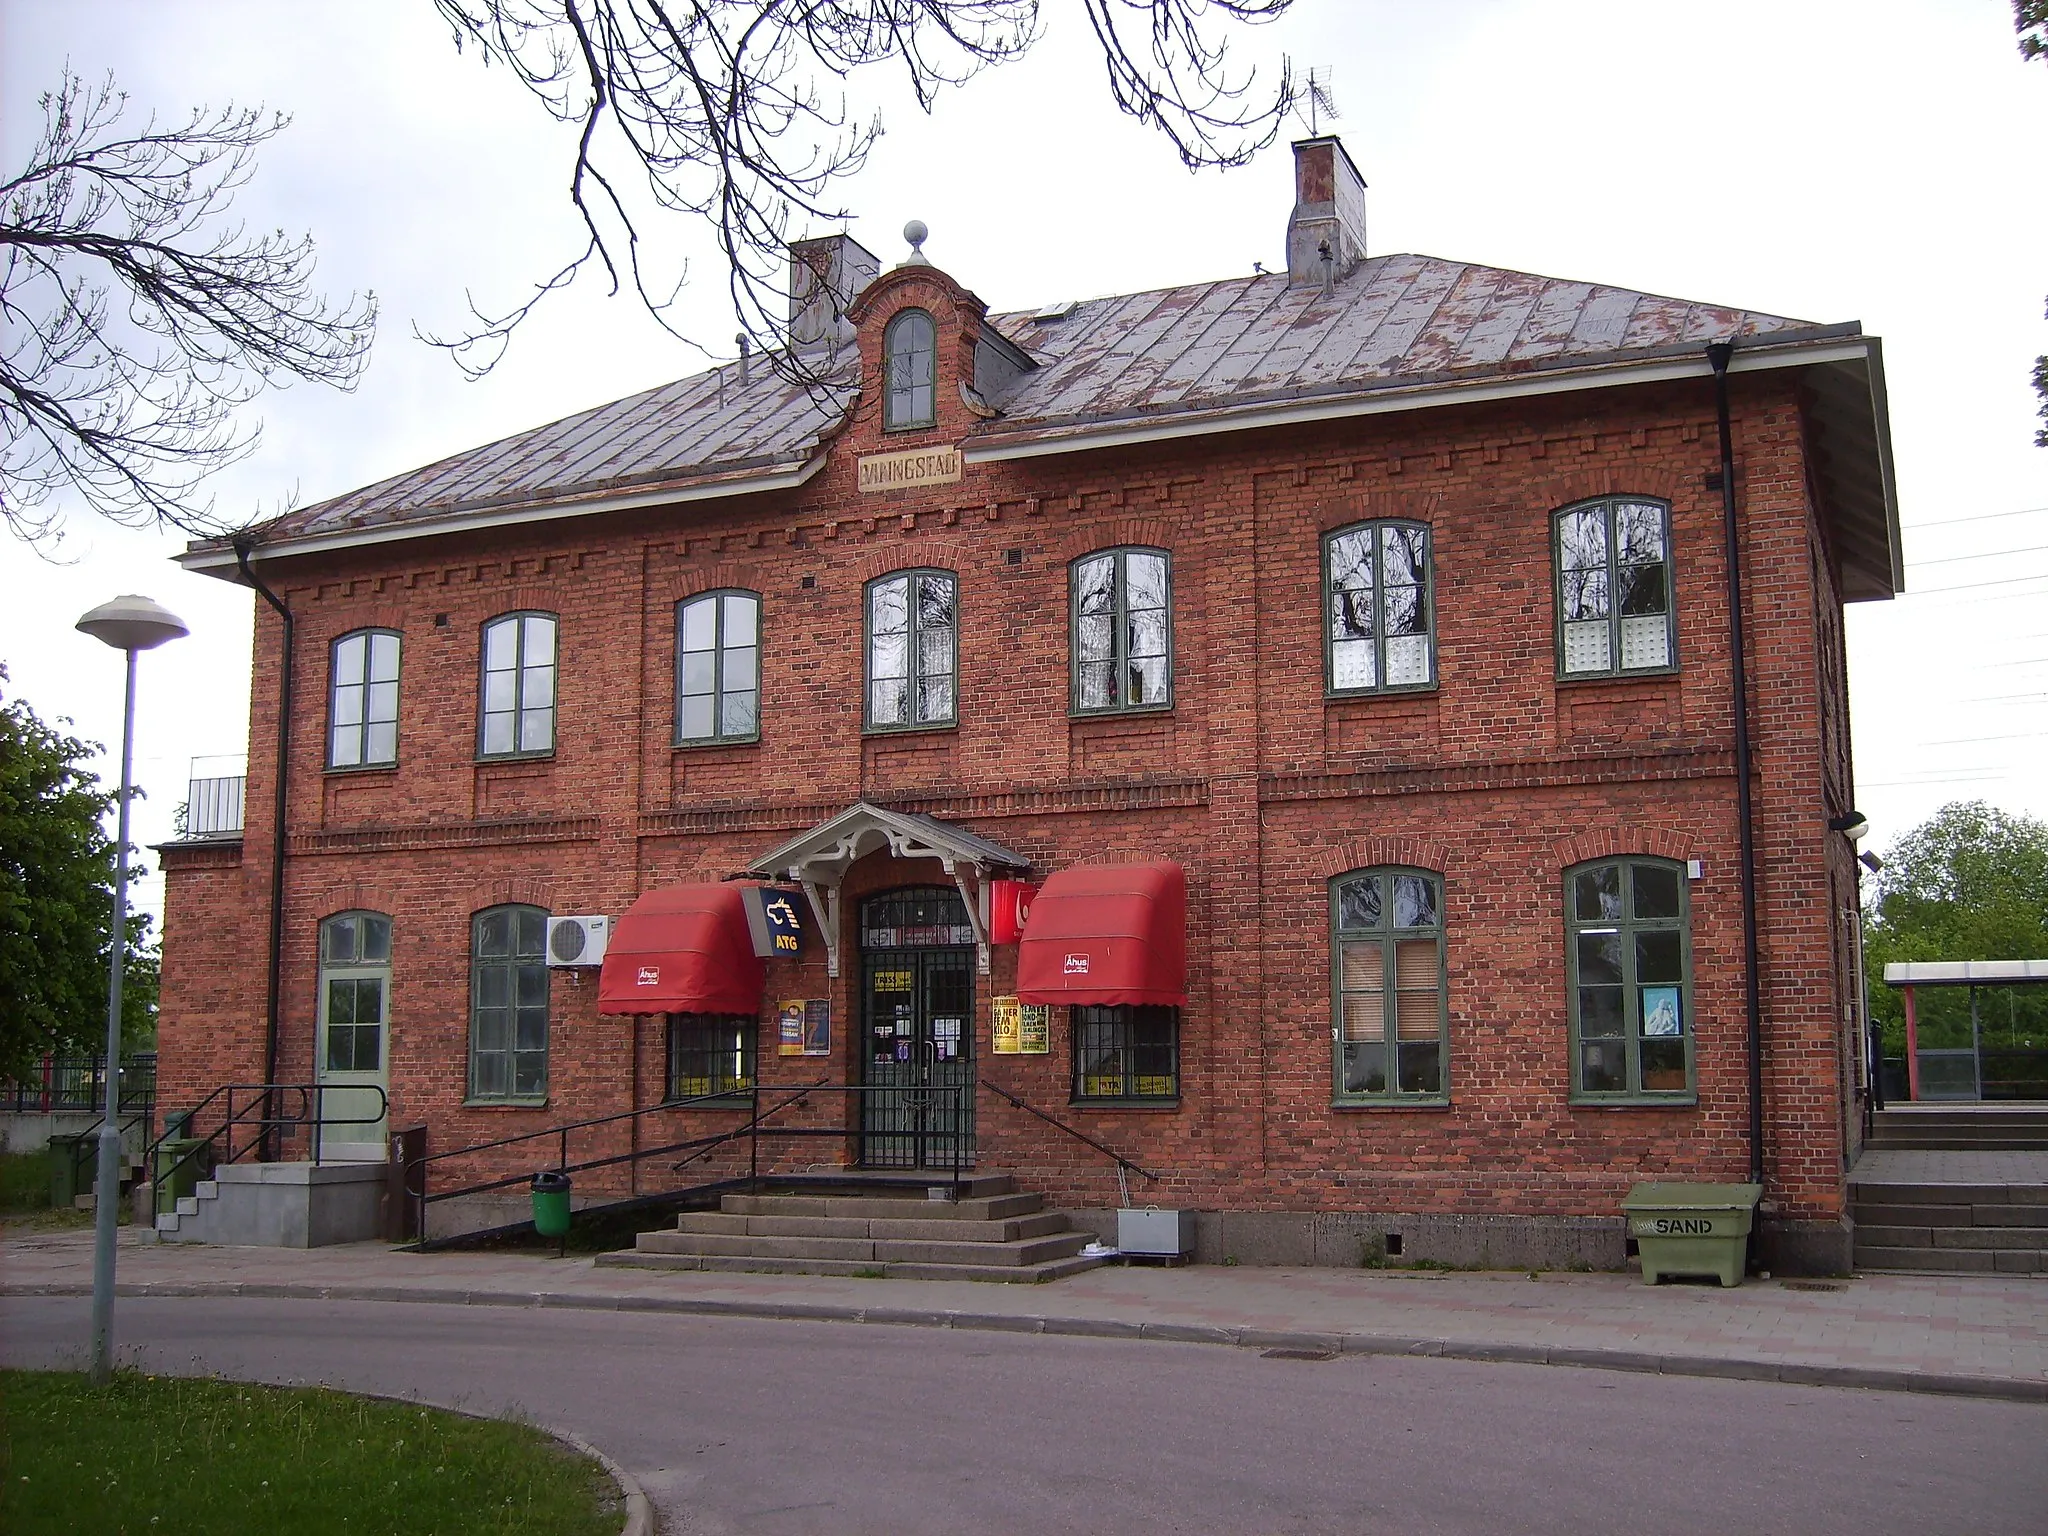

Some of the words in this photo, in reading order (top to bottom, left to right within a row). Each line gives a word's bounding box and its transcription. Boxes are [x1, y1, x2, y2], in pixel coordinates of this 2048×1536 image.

[776, 934, 798, 951] ATG
[1066, 955, 1087, 966] Åhus
[1656, 1219, 1713, 1234] SAND
